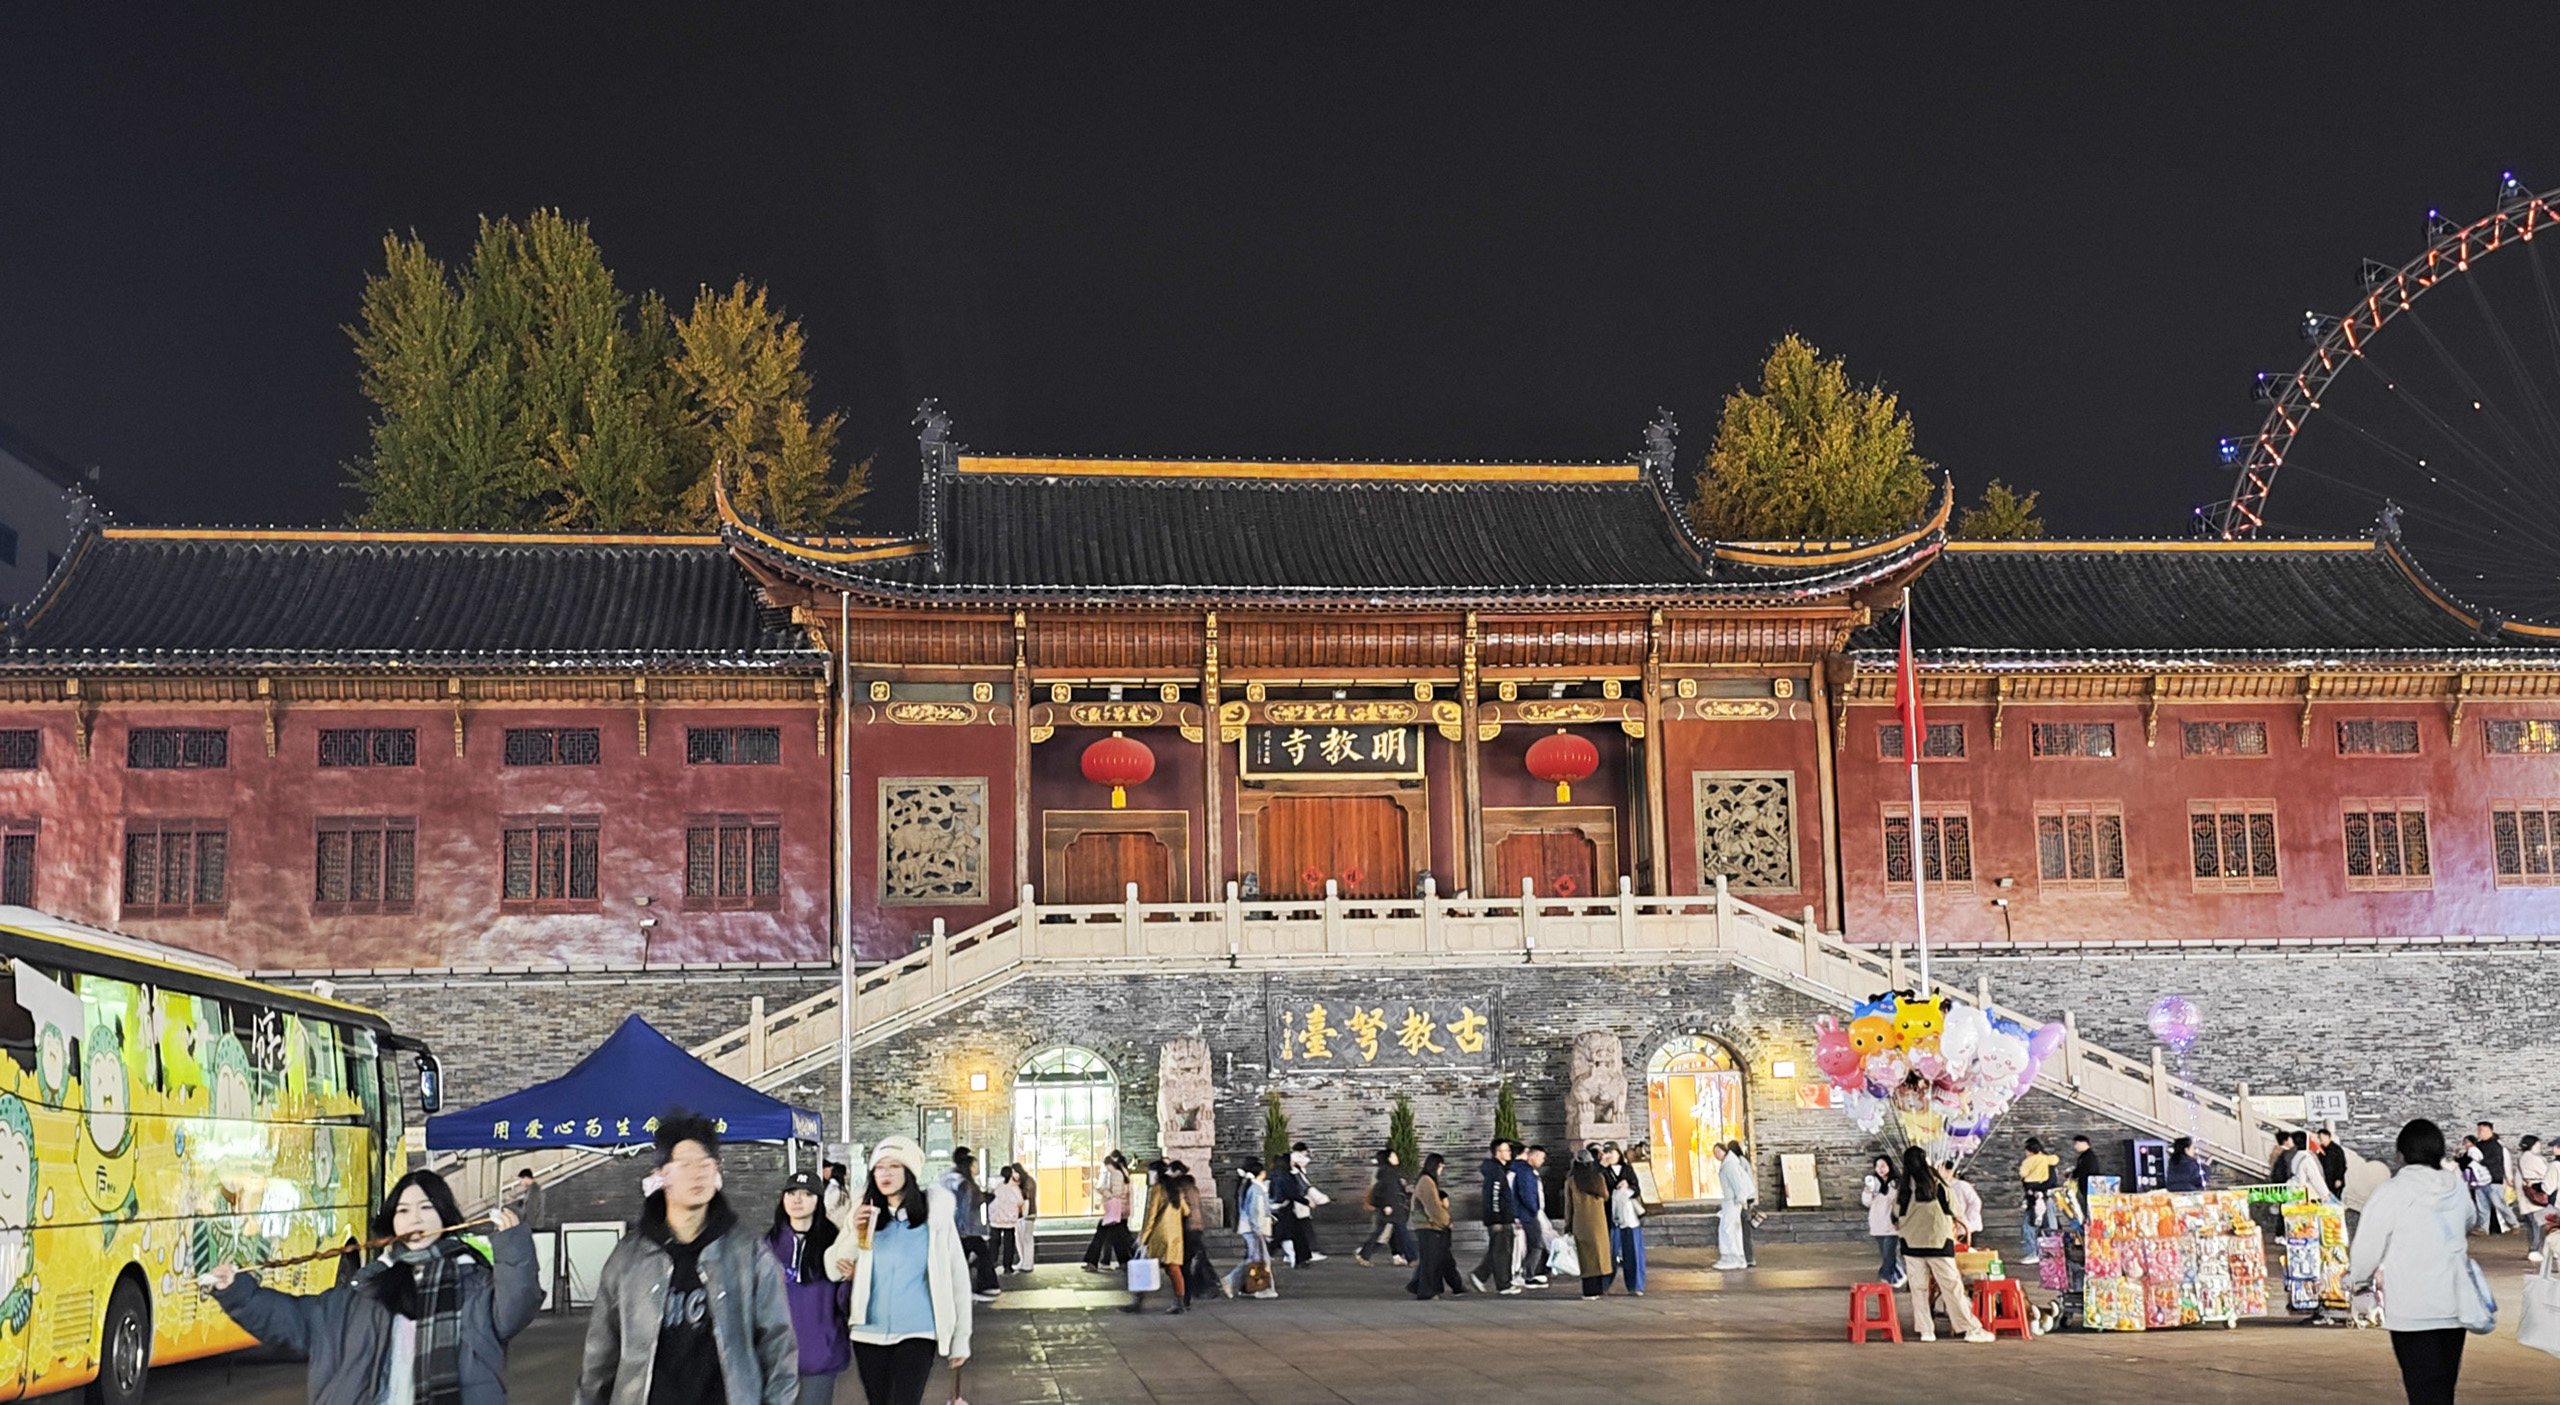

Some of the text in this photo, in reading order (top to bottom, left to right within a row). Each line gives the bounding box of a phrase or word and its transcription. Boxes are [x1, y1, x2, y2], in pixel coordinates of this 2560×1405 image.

[2311, 1095, 2341, 1110] 进口
[493, 1116, 728, 1140] 用爱心为生命油
